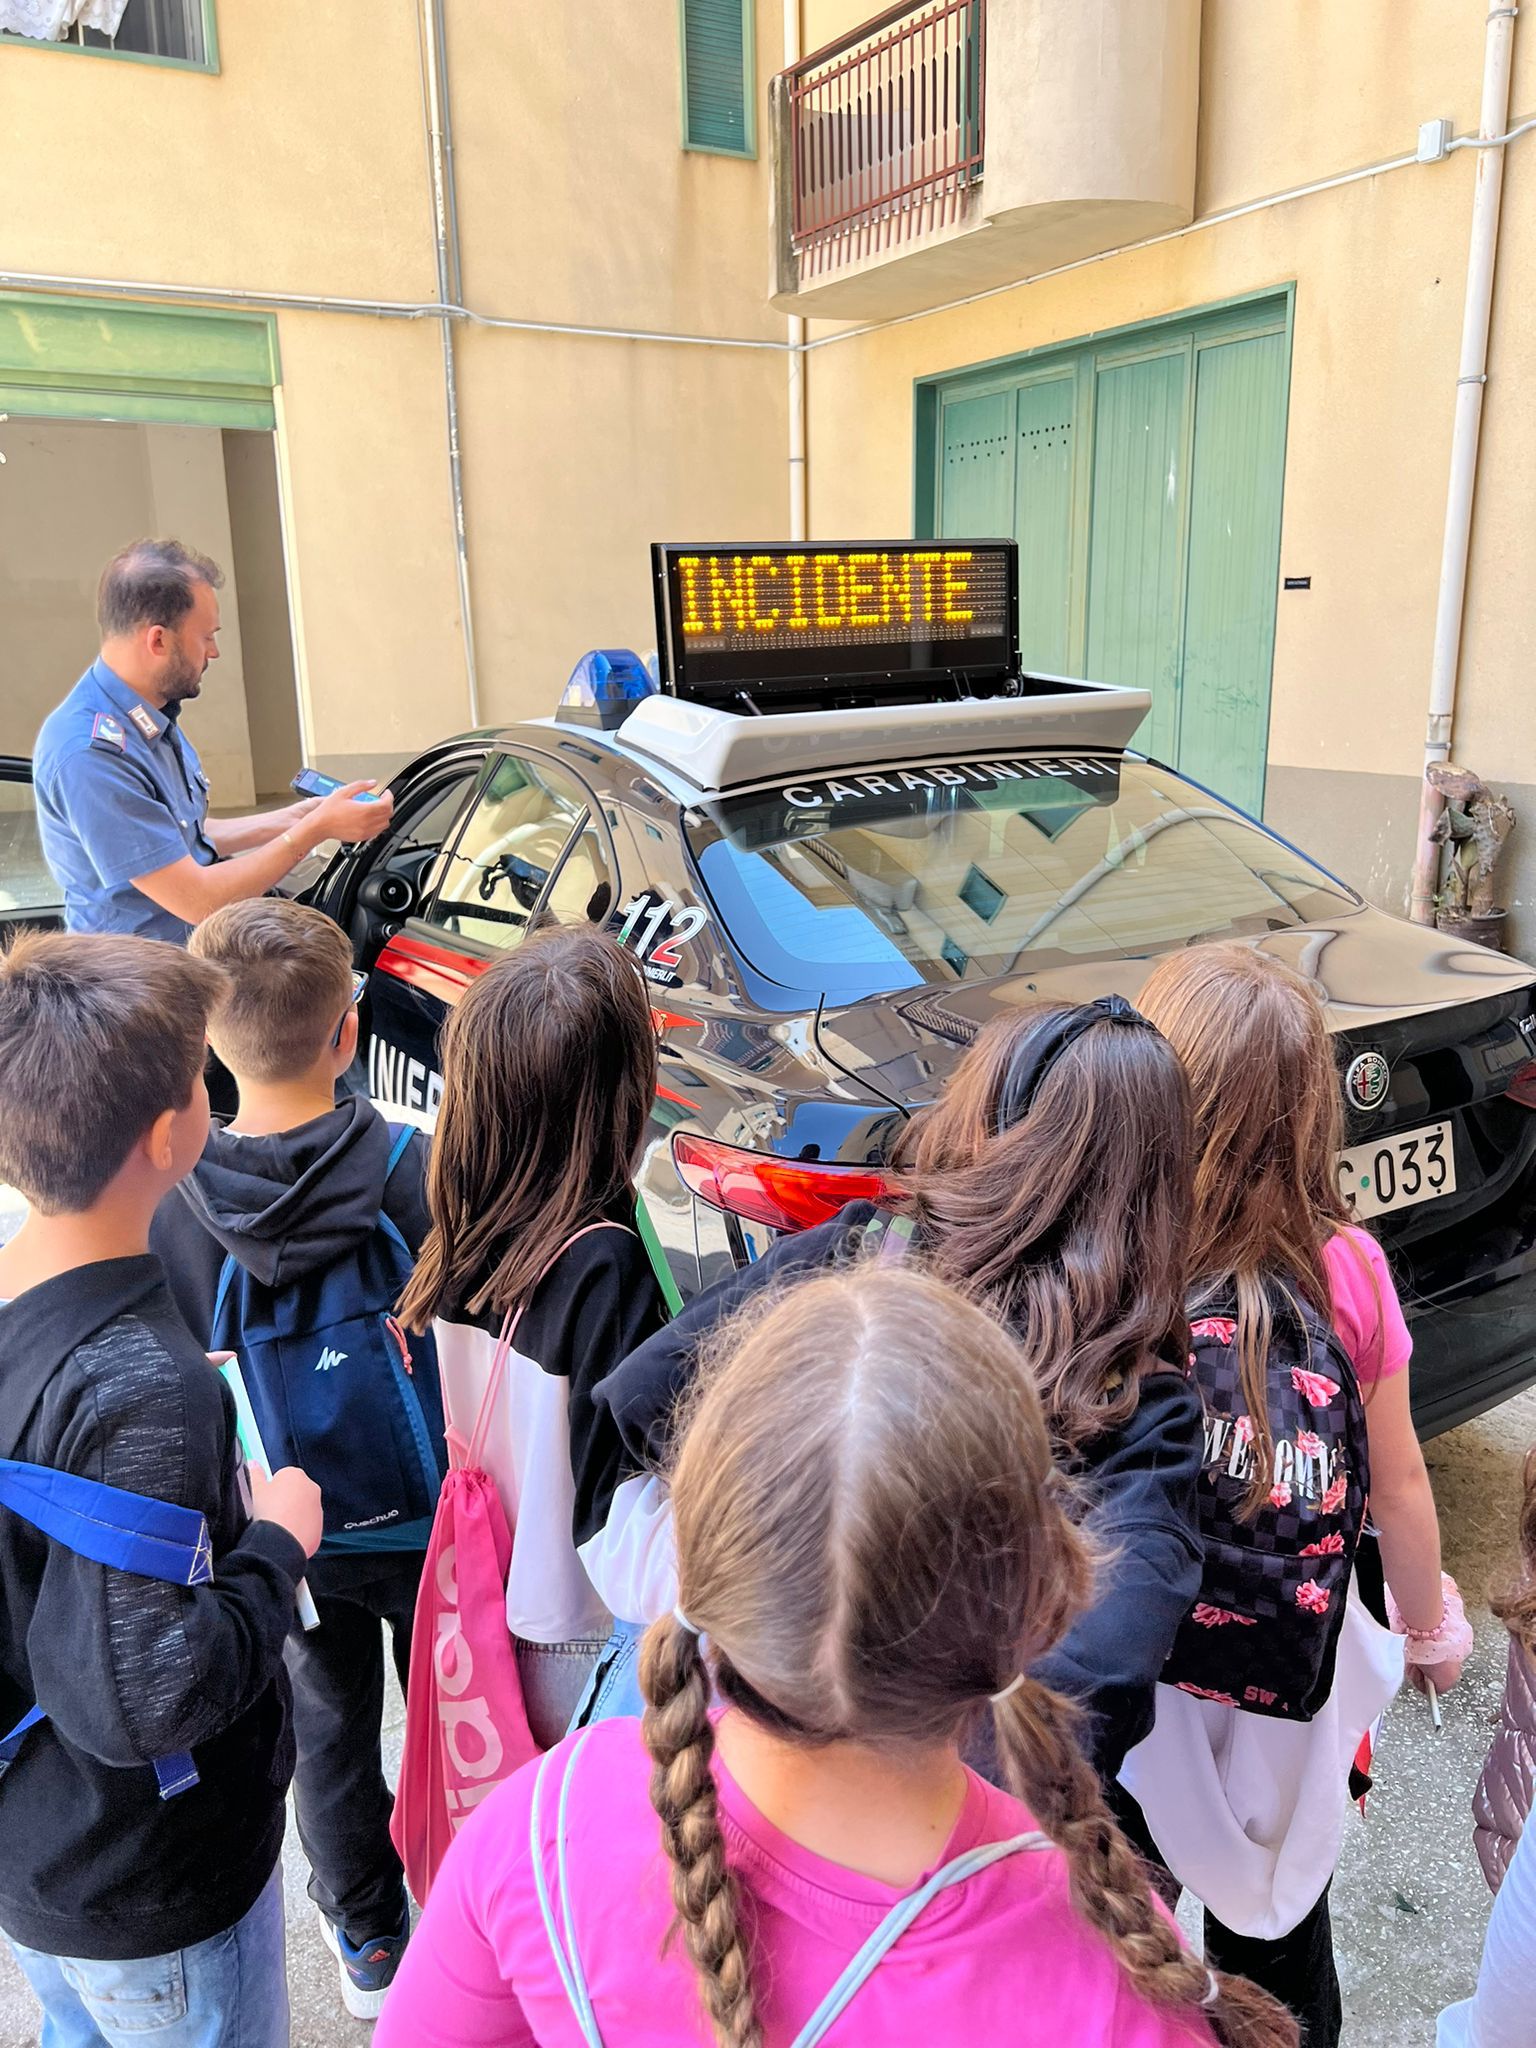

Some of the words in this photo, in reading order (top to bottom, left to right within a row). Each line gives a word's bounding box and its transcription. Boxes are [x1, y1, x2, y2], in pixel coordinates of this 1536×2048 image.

[678, 551, 973, 633] INCIDENTE
[782, 756, 1119, 808] CARABINIERI
[617, 894, 707, 967] 112
[1374, 1132, 1447, 1204] 033
